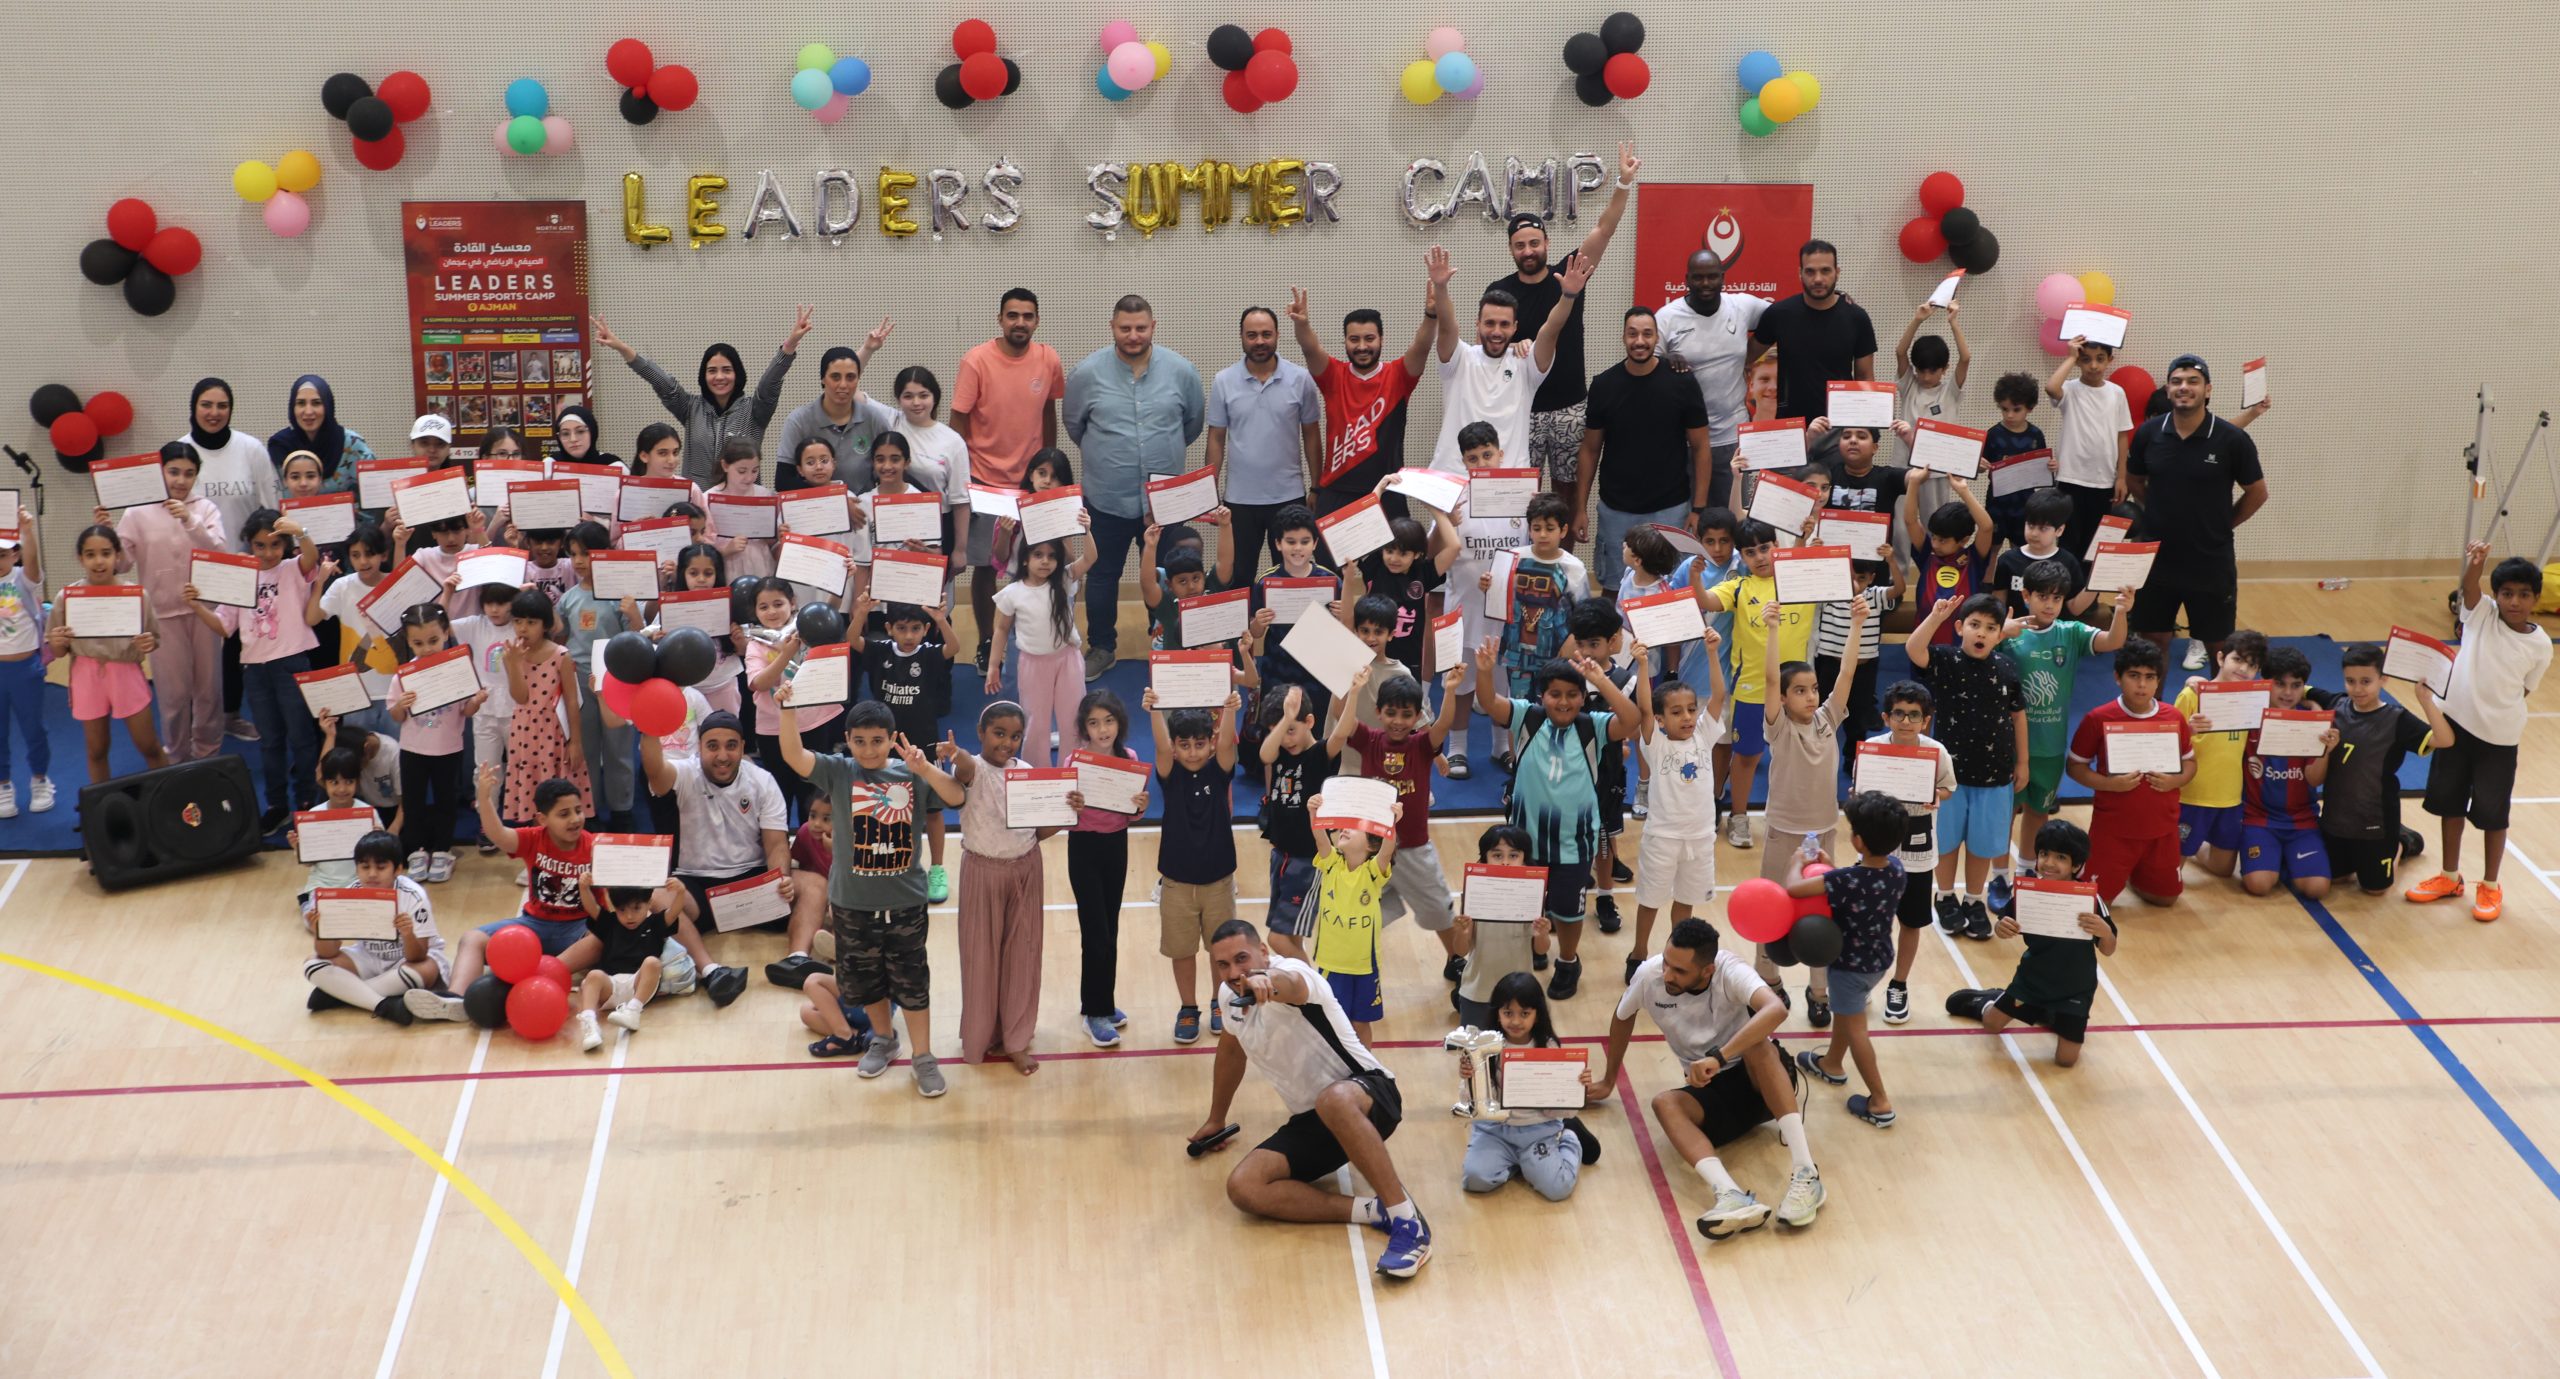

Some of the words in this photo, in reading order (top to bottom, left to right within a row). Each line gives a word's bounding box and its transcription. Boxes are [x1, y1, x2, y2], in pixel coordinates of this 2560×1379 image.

[622, 158, 1026, 247] LEADERS
[1086, 157, 1342, 240] SUMMER
[1403, 151, 1607, 228] CAMP
[454, 242, 486, 253] القادة
[490, 243, 531, 255] معسكر
[434, 274, 554, 291] LEADERS
[1749, 282, 1777, 292] القادة
[435, 293, 480, 301] SUMMER
[482, 292, 523, 301] SPORTS
[525, 292, 556, 300] CAMP
[479, 303, 517, 311] AJMAN
[1333, 397, 1385, 453] LEAD
[1331, 430, 1371, 473] ERS
[1465, 536, 1520, 548] Emirates
[1474, 550, 1486, 560] FLY
[1750, 612, 1800, 628] KFD
[882, 680, 920, 695] Emirates
[891, 695, 914, 705] BETTER
[2343, 743, 2355, 764] 7
[2265, 766, 2304, 781] Spotify
[871, 842, 896, 855] THE
[2381, 857, 2392, 878] 7
[1322, 908, 1371, 929] KAFD
